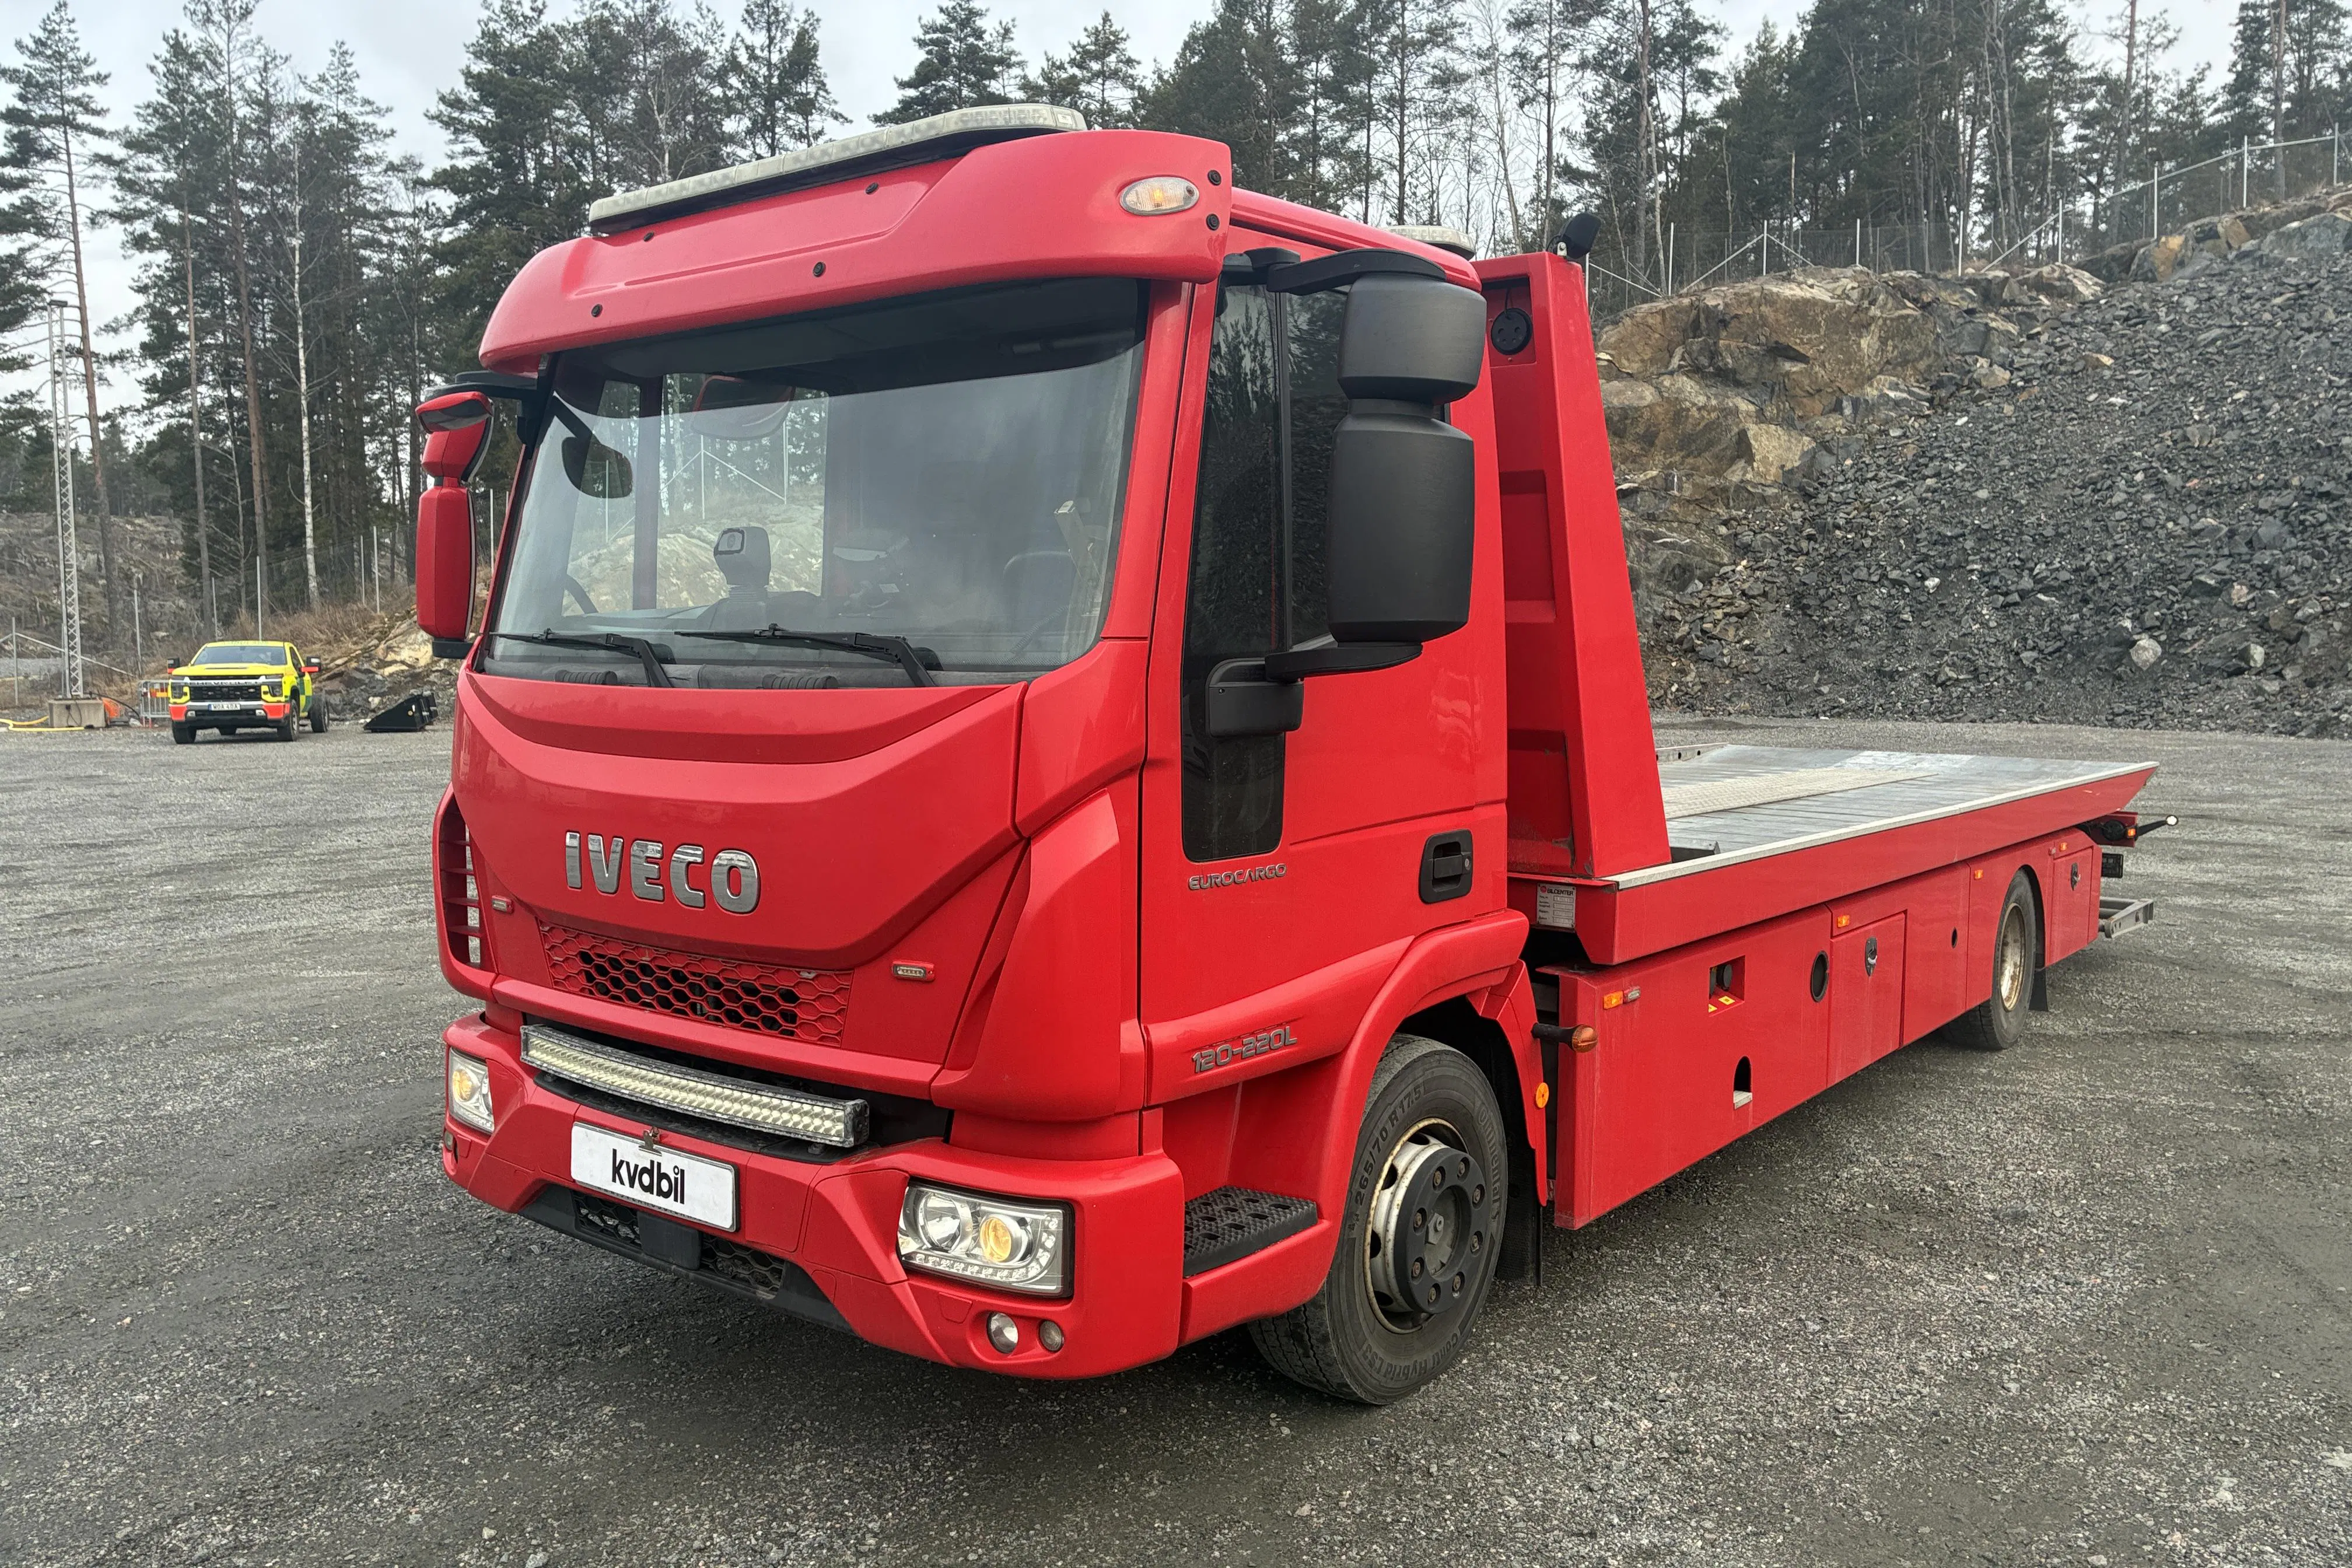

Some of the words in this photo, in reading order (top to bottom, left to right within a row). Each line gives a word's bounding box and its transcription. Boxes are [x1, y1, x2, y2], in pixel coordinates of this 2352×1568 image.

[565, 831, 761, 914] IVECO
[1188, 863, 1287, 890] EUROCARGO
[1546, 888, 1574, 896] BILCENTER
[1192, 1026, 1297, 1073] 120-220L
[1354, 1128, 1389, 1206] 265/70
[1388, 1110, 1399, 1128] R
[1399, 1086, 1423, 1116] 17.5
[611, 1149, 685, 1205] kvdbil
[1383, 1359, 1427, 1381] Hybrid
[1431, 1332, 1458, 1371] Conti
